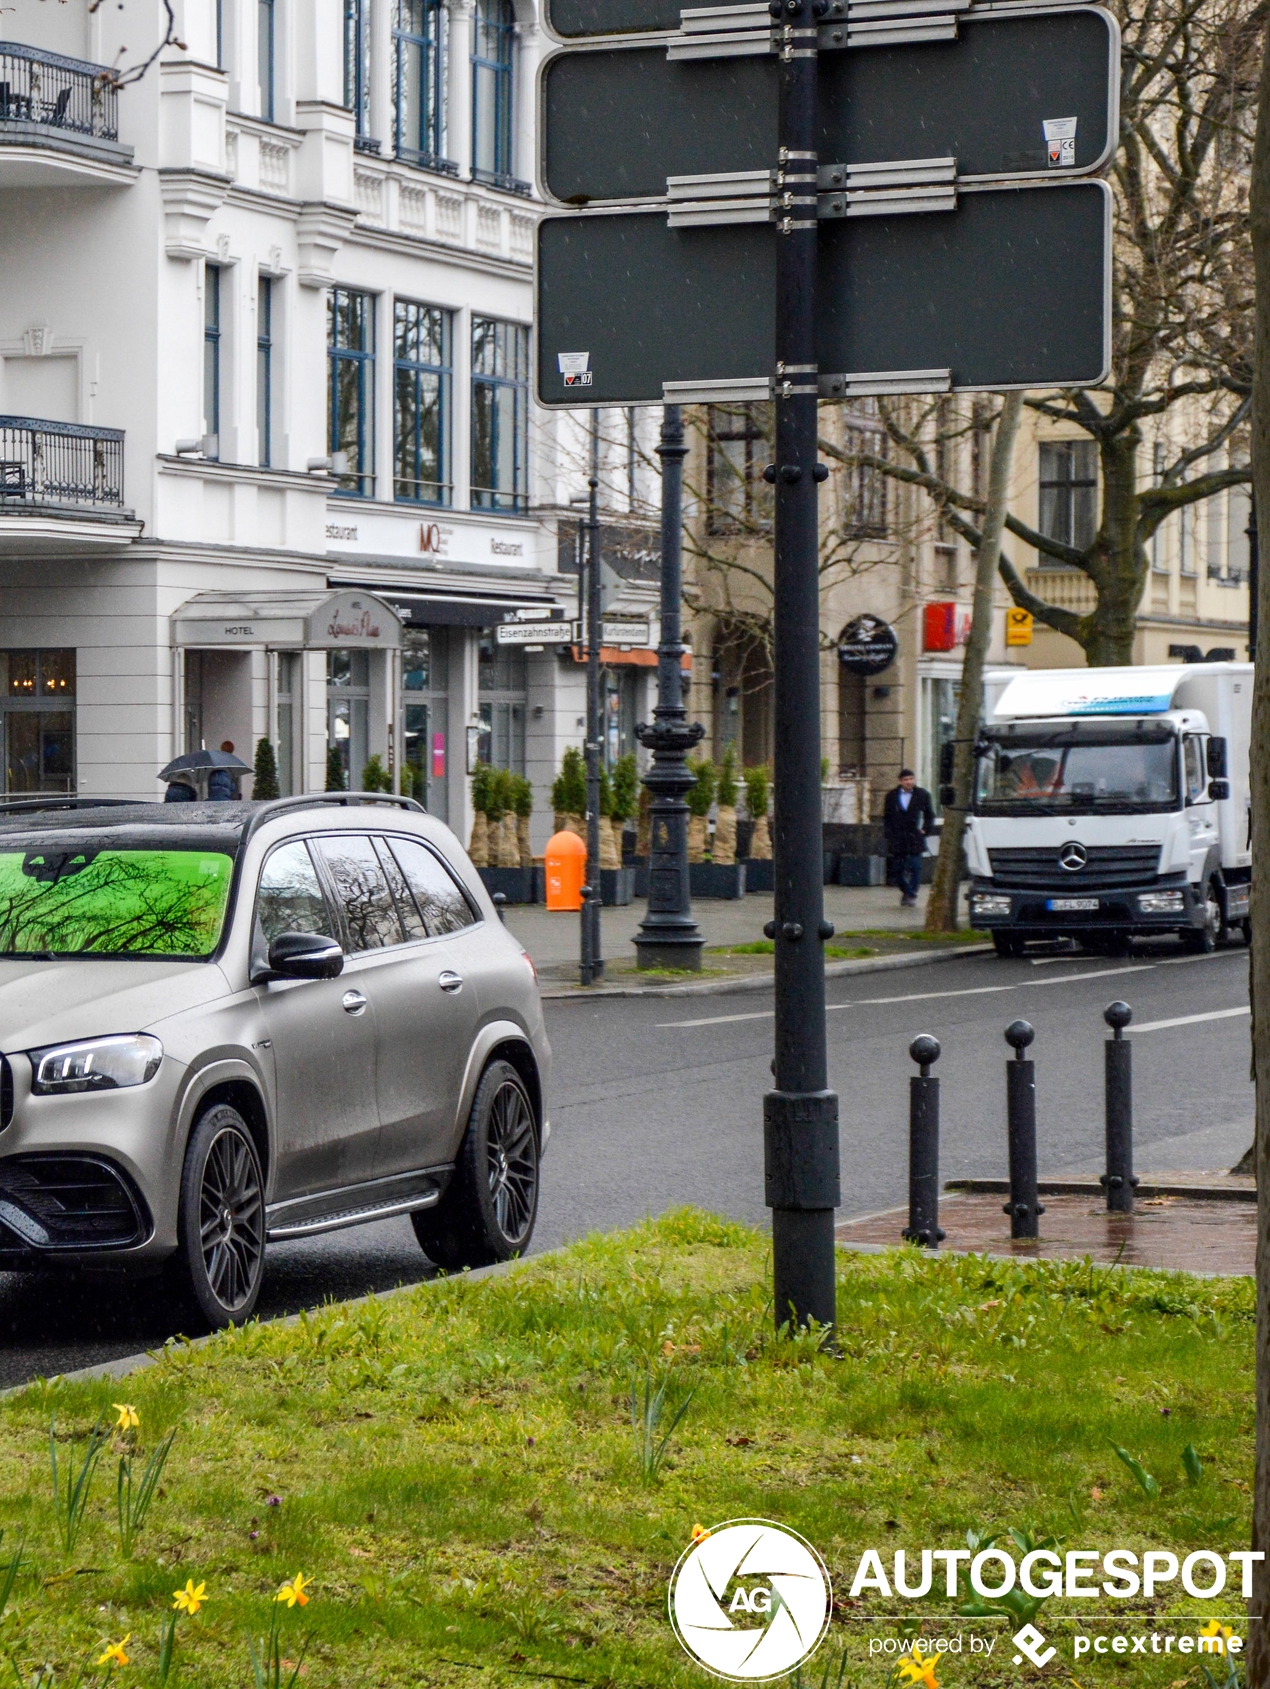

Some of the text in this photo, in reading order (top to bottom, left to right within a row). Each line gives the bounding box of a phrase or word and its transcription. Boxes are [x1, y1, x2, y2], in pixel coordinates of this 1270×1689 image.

[325, 523, 358, 540] estaurant
[491, 538, 524, 556] Restaurant
[225, 627, 254, 635] HOTEL
[500, 626, 571, 639] Eisenzahnstraße
